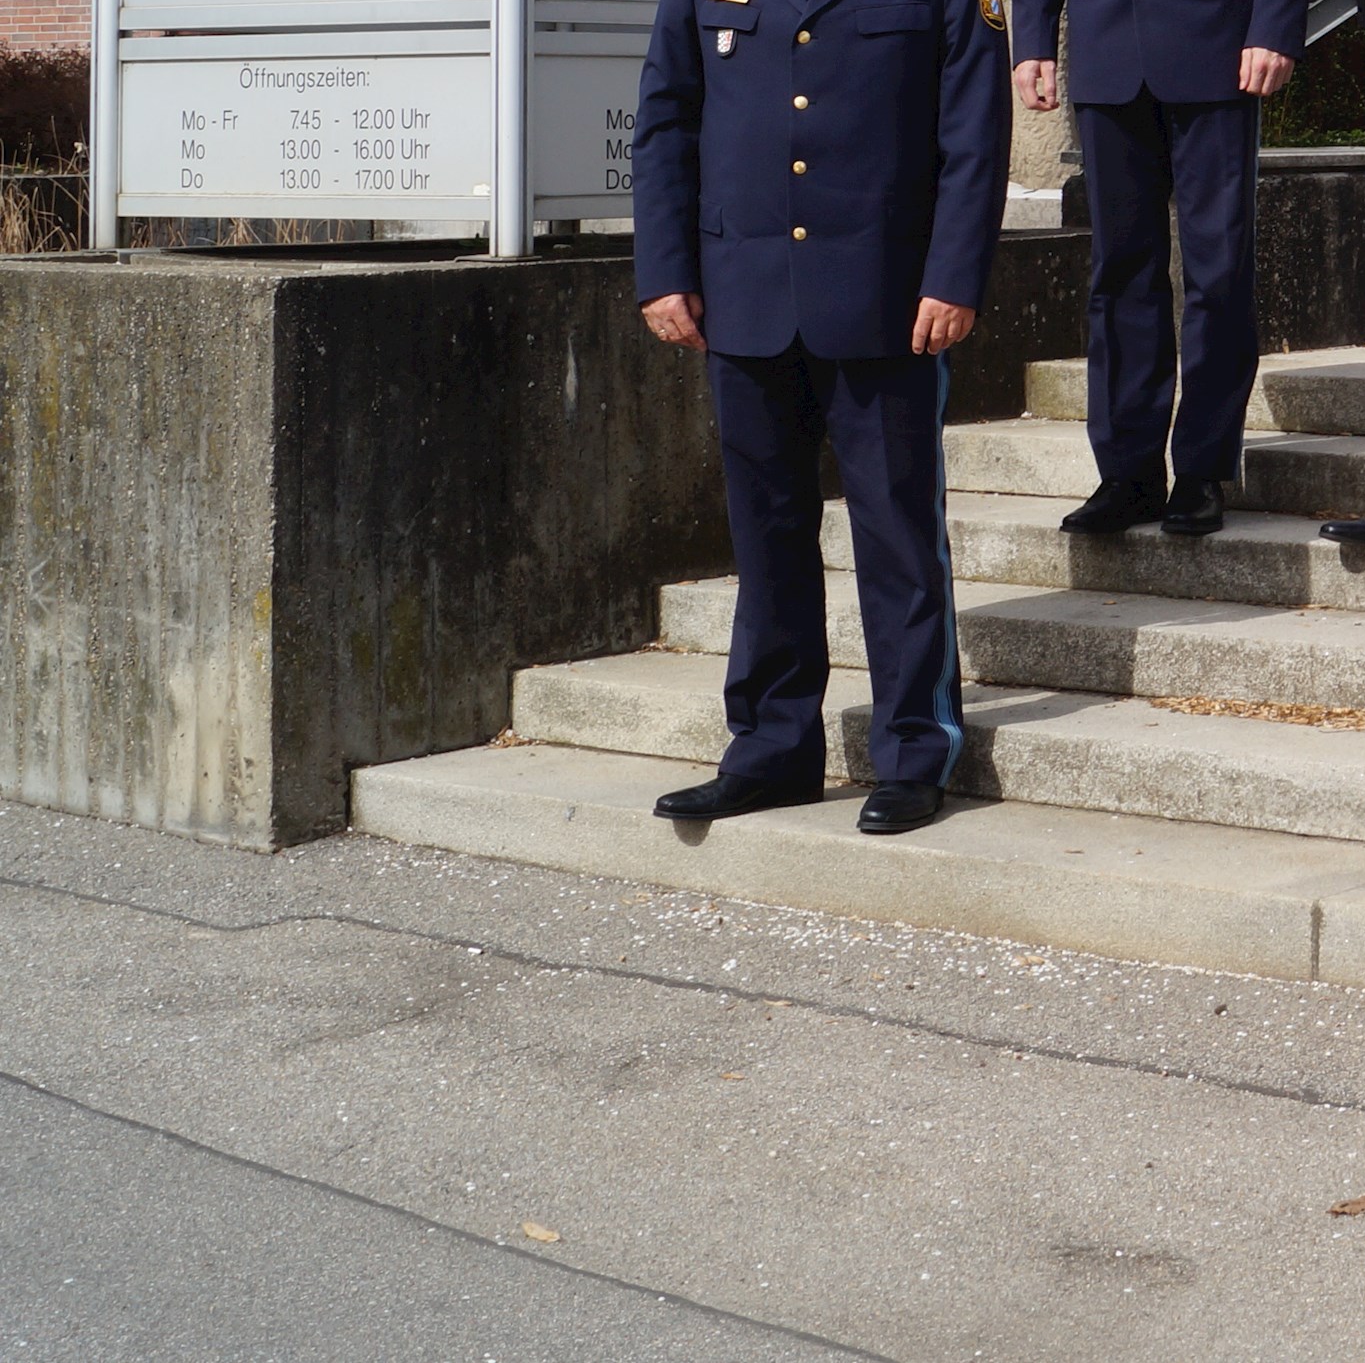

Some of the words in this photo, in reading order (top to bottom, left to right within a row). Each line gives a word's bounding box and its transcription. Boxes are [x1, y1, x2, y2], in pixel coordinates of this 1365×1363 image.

[239, 64, 371, 93] Öffnungszeiten:
[181, 110, 206, 131] Mo
[222, 109, 239, 130] Fr
[290, 110, 322, 130] 7.45
[352, 108, 395, 130] 12.00
[401, 108, 431, 130] Uhr
[606, 109, 635, 130] Mo
[181, 139, 206, 160] Mo
[280, 139, 321, 160] 13.00
[353, 139, 395, 160] 16.00
[401, 138, 431, 160] Uhr
[181, 168, 204, 189] Do
[280, 169, 321, 189] 13.00
[355, 169, 395, 190] 17.00
[401, 169, 430, 190] Uhr
[606, 168, 633, 190] Do
